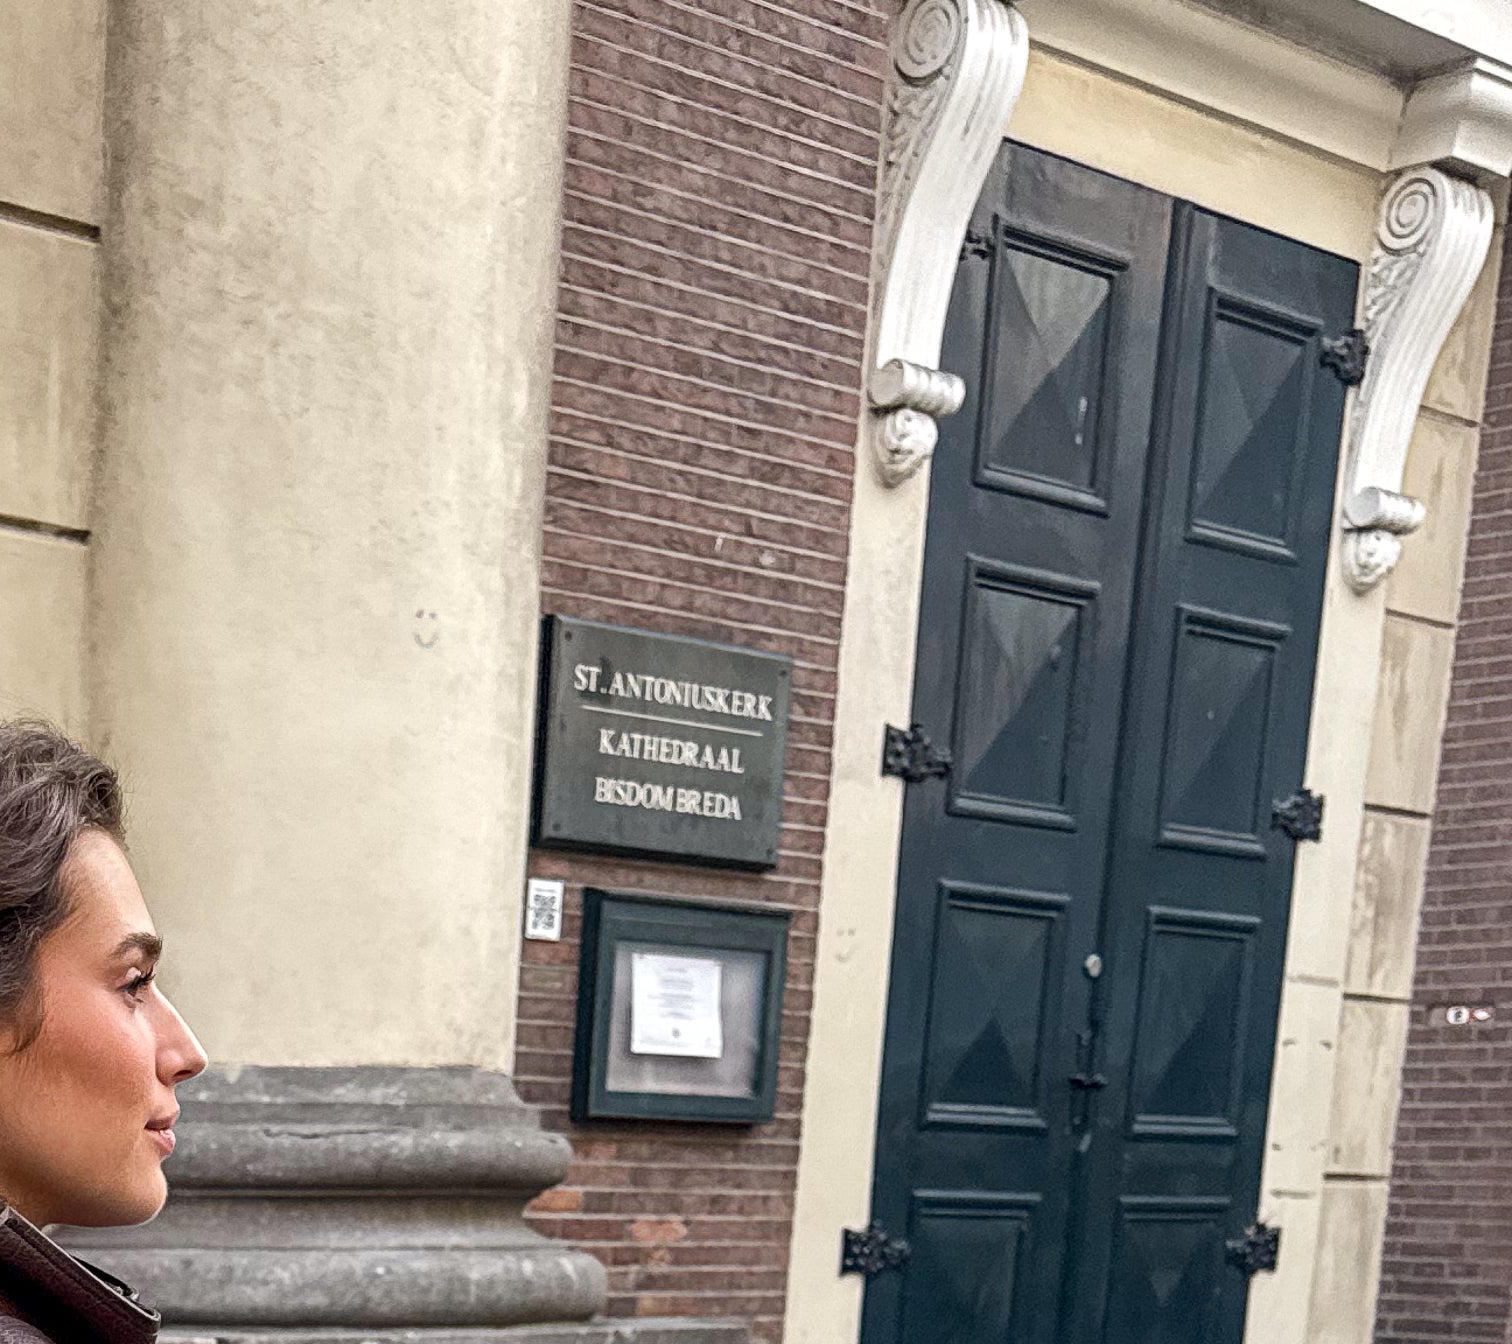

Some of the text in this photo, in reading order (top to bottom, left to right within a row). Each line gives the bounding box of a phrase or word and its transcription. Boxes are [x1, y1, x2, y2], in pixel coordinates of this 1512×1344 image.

[599, 729, 745, 774] KATHEDRAAL
[594, 777, 742, 821] BISDOM BREDA
